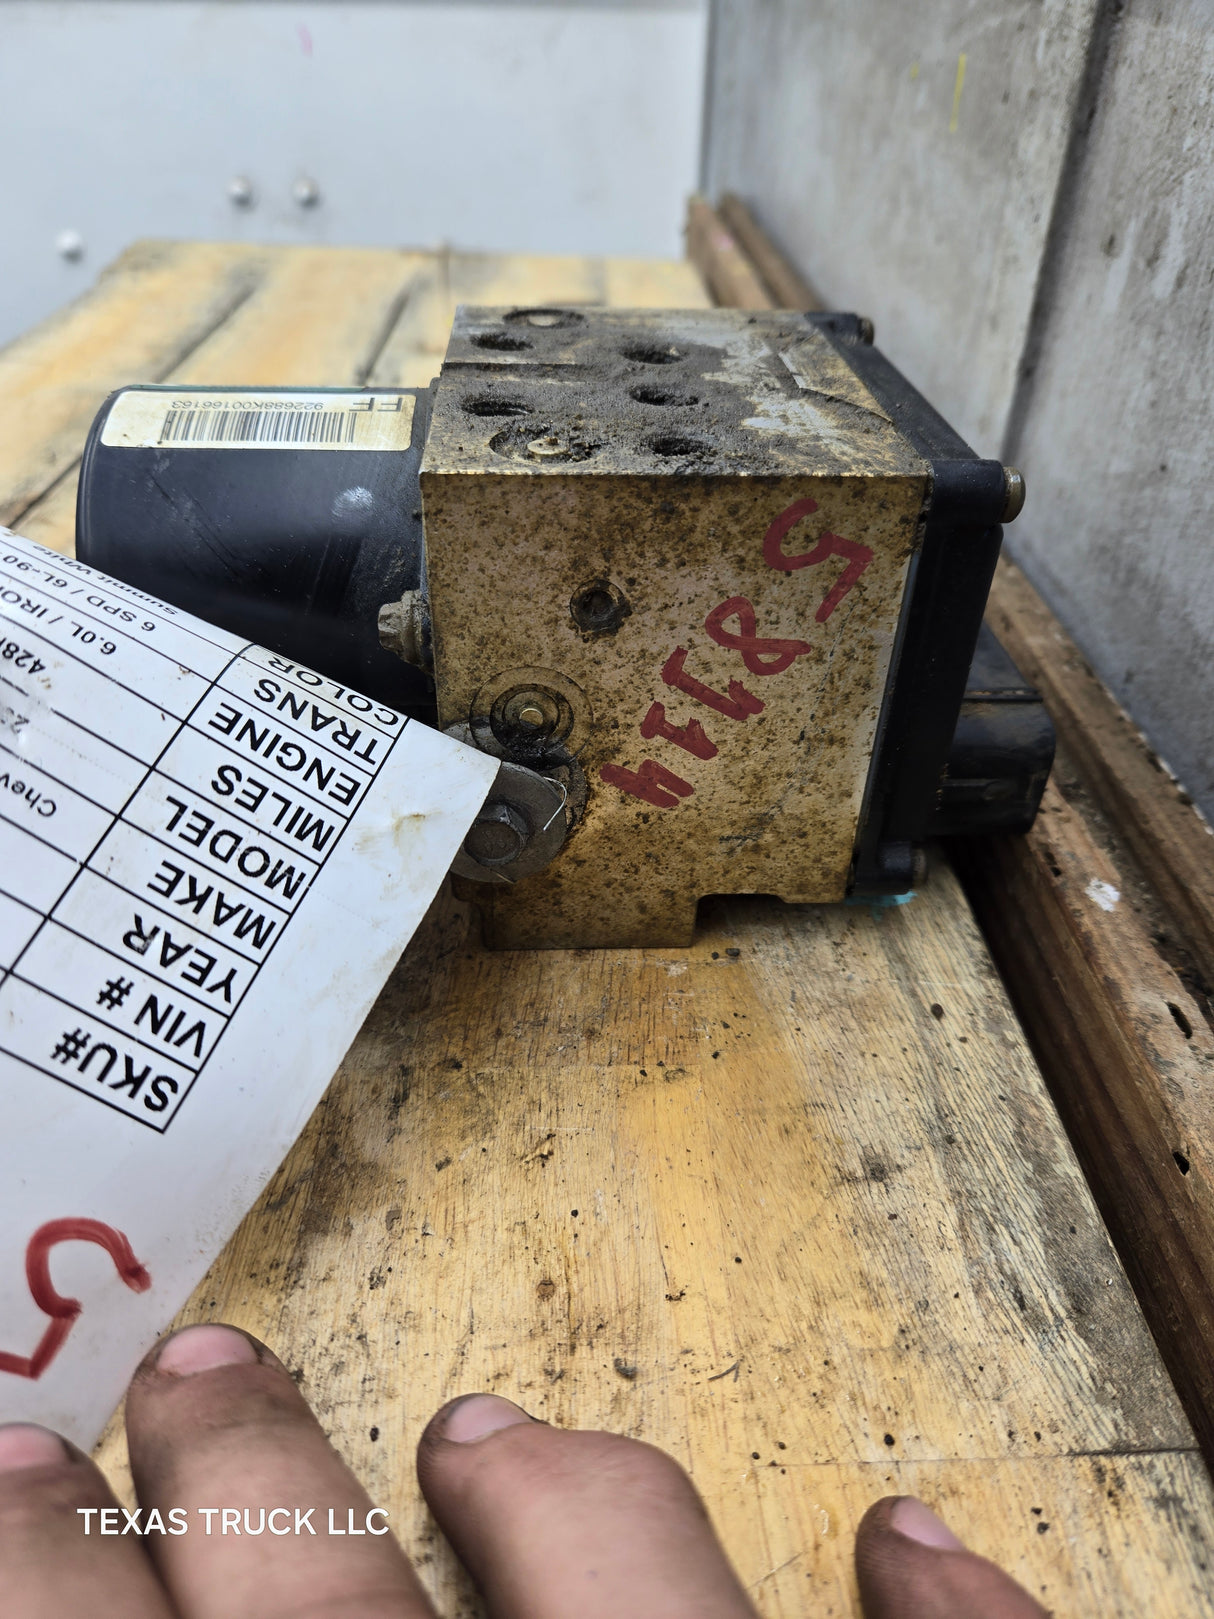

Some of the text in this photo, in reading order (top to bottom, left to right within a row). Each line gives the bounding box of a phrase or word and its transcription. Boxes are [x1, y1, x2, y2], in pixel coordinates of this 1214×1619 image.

[349, 397, 403, 412] FF
[0, 552, 68, 588] 6L-90
[32, 545, 178, 616] Summit White
[86, 595, 137, 623] SPD
[47, 615, 64, 624] /
[71, 620, 117, 655] 6.0L
[141, 619, 156, 633] 6
[601, 499, 874, 808] 58114
[253, 678, 378, 765] TRANS
[267, 656, 400, 727] COLOR
[208, 702, 361, 806] ENGINE
[165, 796, 307, 900] MODEL
[210, 764, 335, 852] MILES
[147, 860, 276, 949] MAKE
[122, 914, 237, 1003] YEAR
[96, 975, 206, 1058] VIN #
[49, 1027, 179, 1113] SKU#
